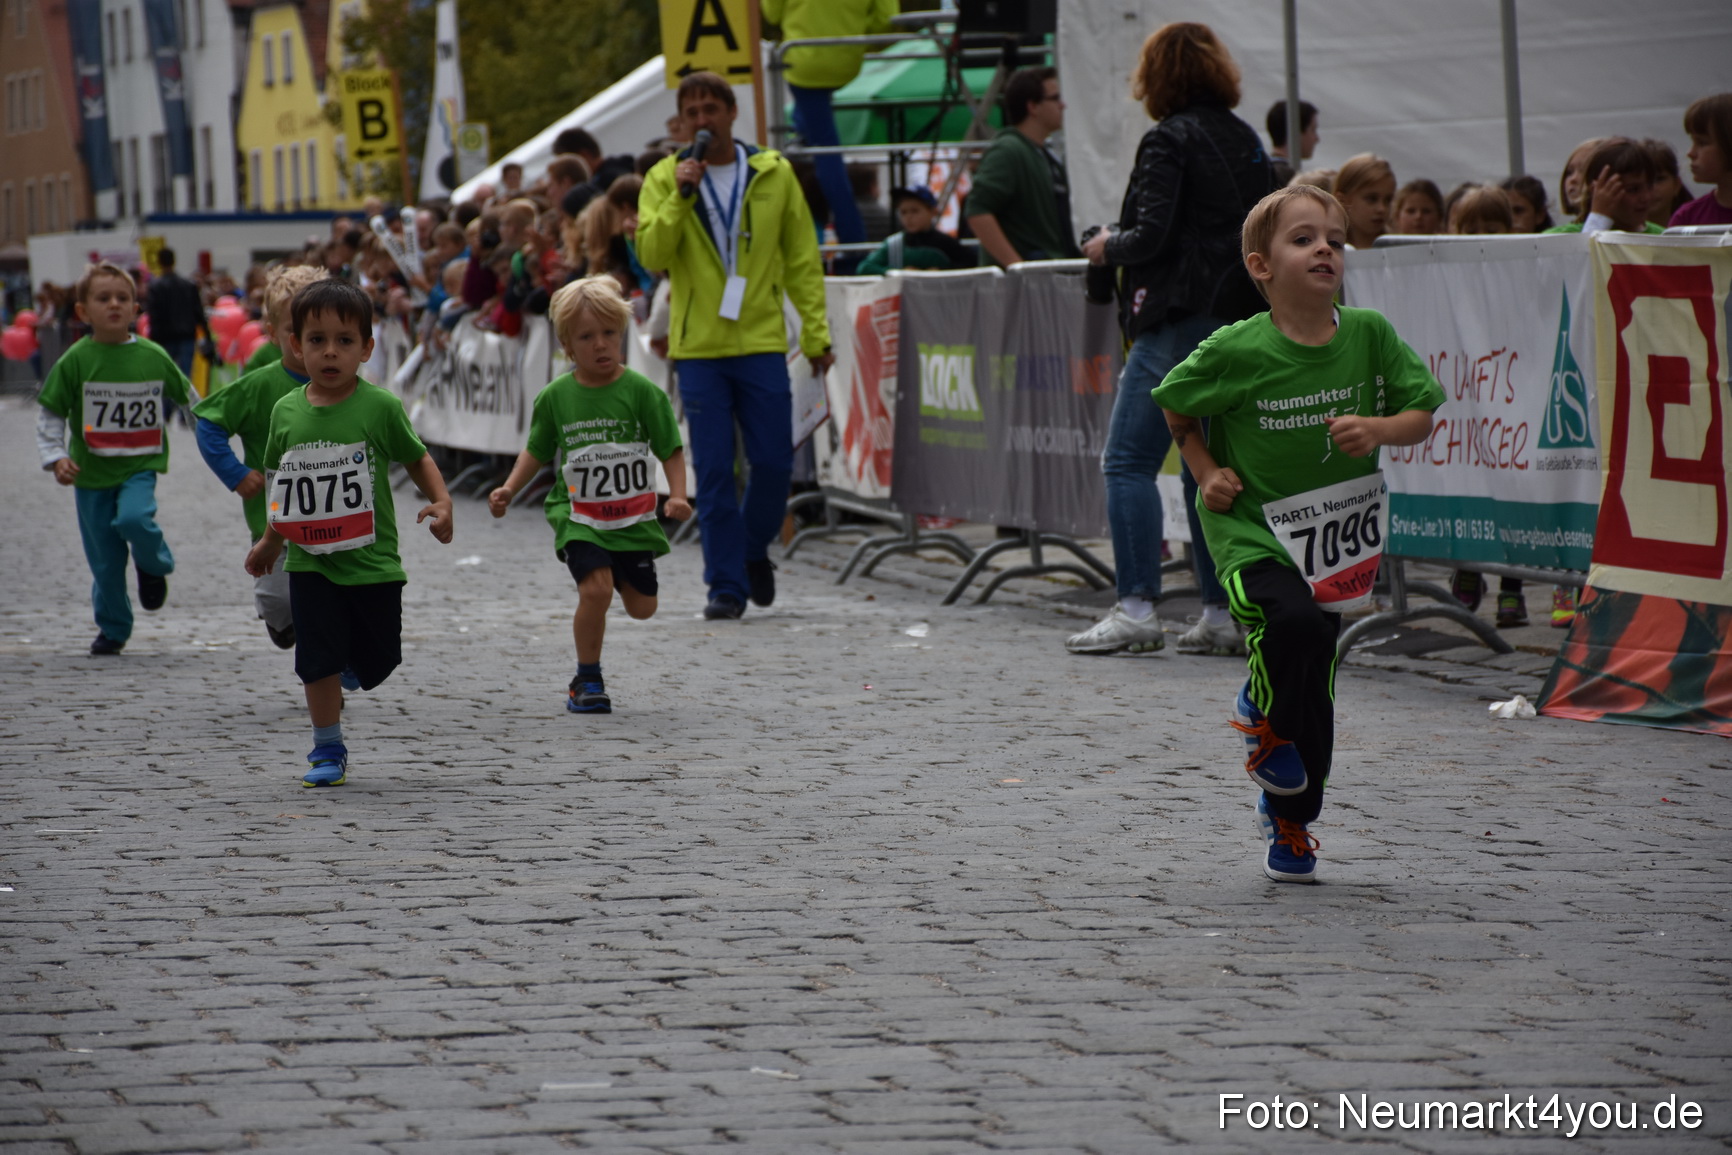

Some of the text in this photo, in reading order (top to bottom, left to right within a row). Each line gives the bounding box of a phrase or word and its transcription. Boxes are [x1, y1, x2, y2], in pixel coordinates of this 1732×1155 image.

[684, 0, 739, 53] A
[345, 76, 391, 92] Block
[357, 99, 389, 141] B
[1256, 386, 1353, 411] Neumarkter
[92, 399, 157, 428] 7423
[1259, 407, 1337, 430] Stadtlauf
[299, 456, 349, 471] Neumarkt
[573, 459, 648, 498] 7200
[277, 470, 363, 517] 7075
[1270, 488, 1378, 527] PARTL Neumarkt
[602, 506, 627, 517] Max
[301, 525, 343, 541] Timur
[1290, 502, 1381, 577] 7096
